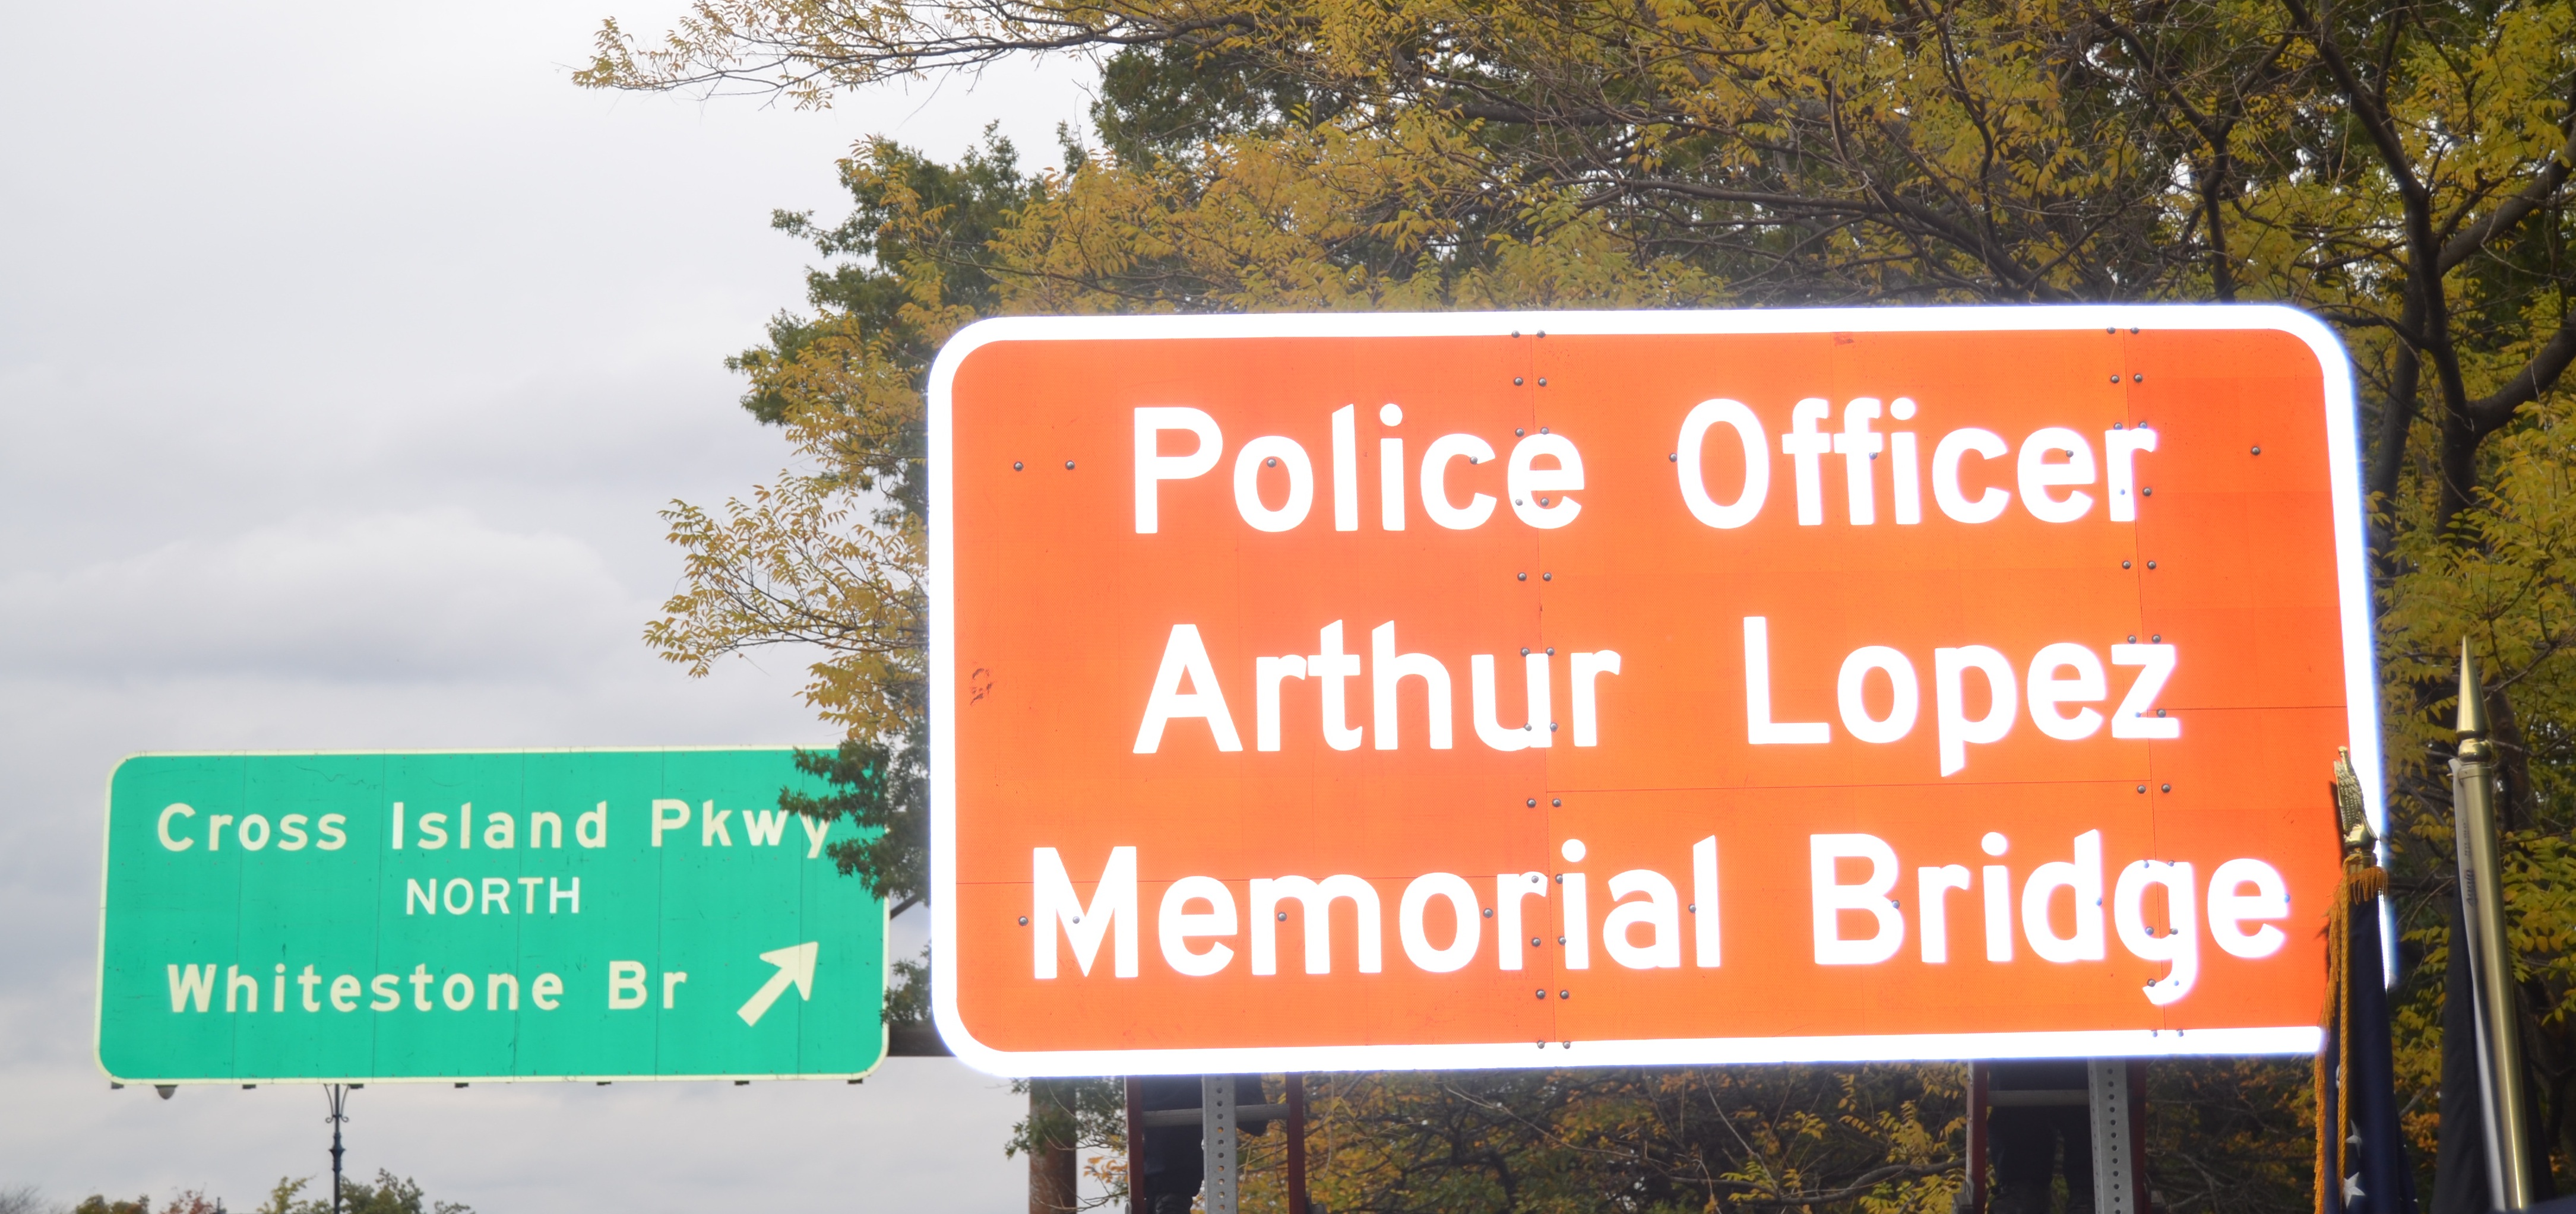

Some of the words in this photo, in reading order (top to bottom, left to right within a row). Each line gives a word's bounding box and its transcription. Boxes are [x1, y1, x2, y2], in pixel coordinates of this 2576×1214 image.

[1134, 402, 1586, 534] Police
[1676, 396, 2157, 530] Officer
[1132, 619, 1622, 754] Arthur
[1742, 615, 2181, 777] Lopez
[157, 802, 347, 852] Cross
[392, 800, 607, 850] Island
[651, 798, 831, 860] Pkwy
[406, 876, 580, 915] NORTH
[1032, 834, 1721, 980] Memorial
[1809, 828, 2289, 1007] Bridge
[167, 963, 564, 1013] Whitestone
[608, 960, 688, 1010] Br
